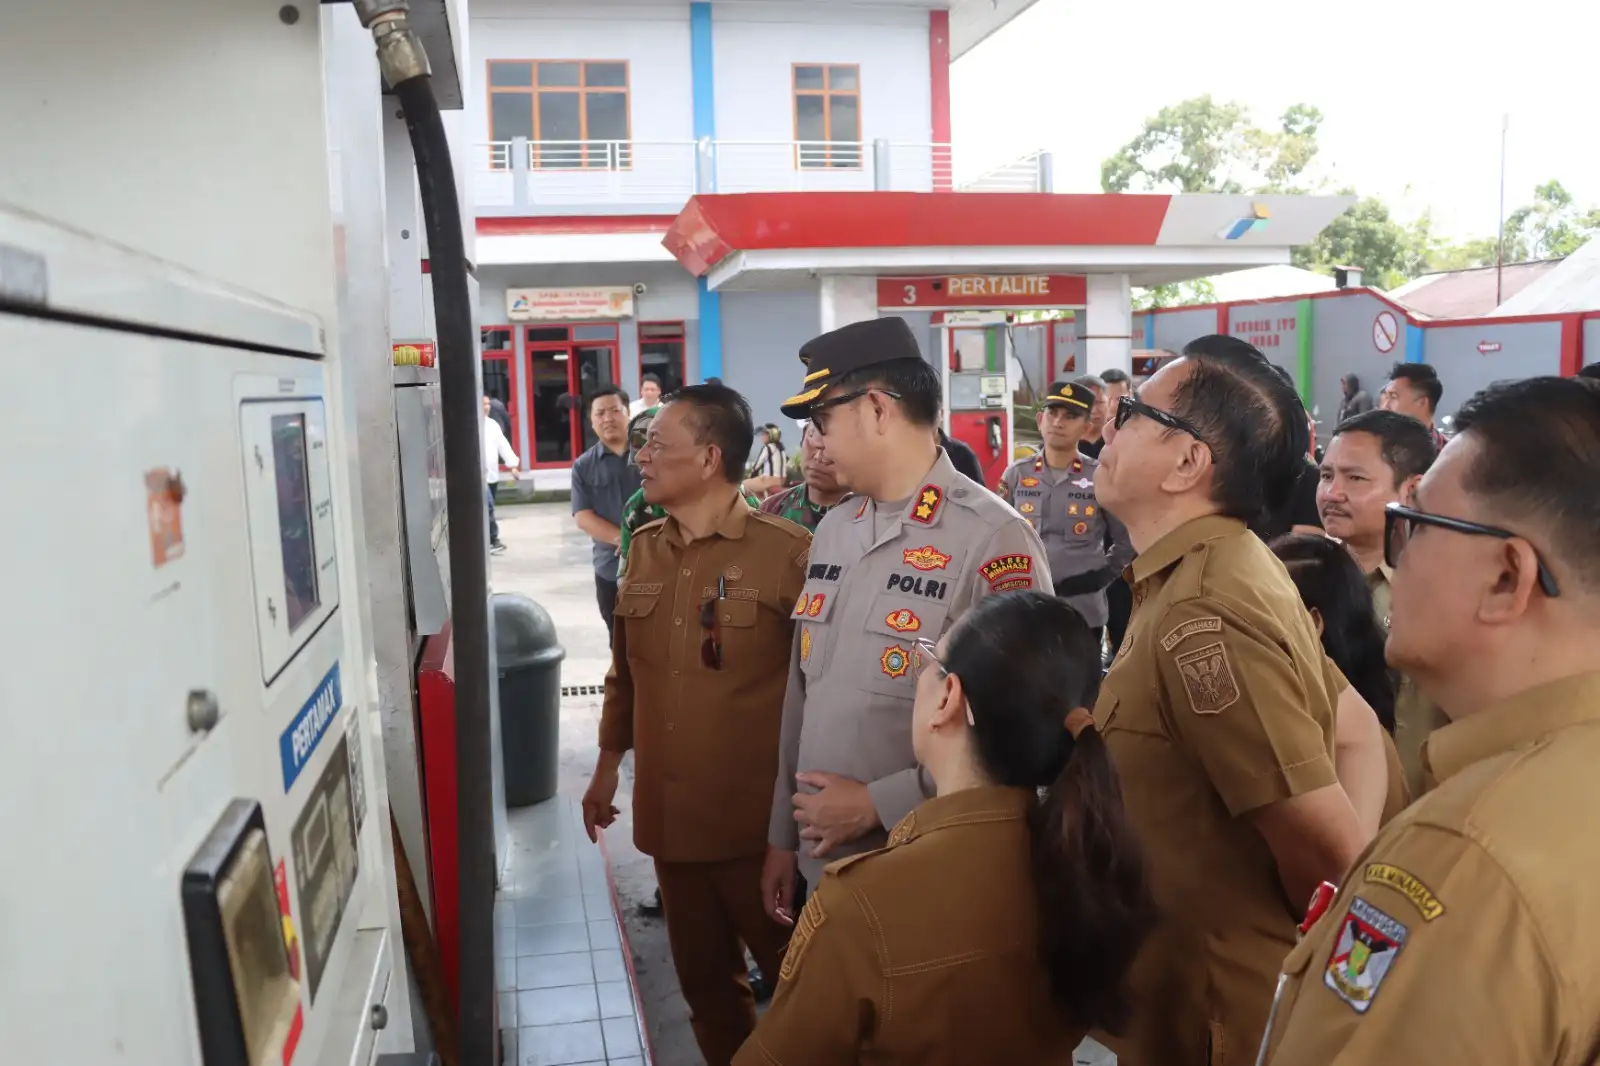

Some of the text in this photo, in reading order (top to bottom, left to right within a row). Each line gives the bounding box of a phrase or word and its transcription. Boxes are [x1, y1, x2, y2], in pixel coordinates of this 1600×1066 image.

[903, 276, 1050, 304] 3 PERTALITE
[983, 556, 1029, 574] POLRES
[988, 563, 1028, 579] MINAHASA
[887, 573, 947, 600] POLRI
[292, 679, 336, 768] PERTAMAX
